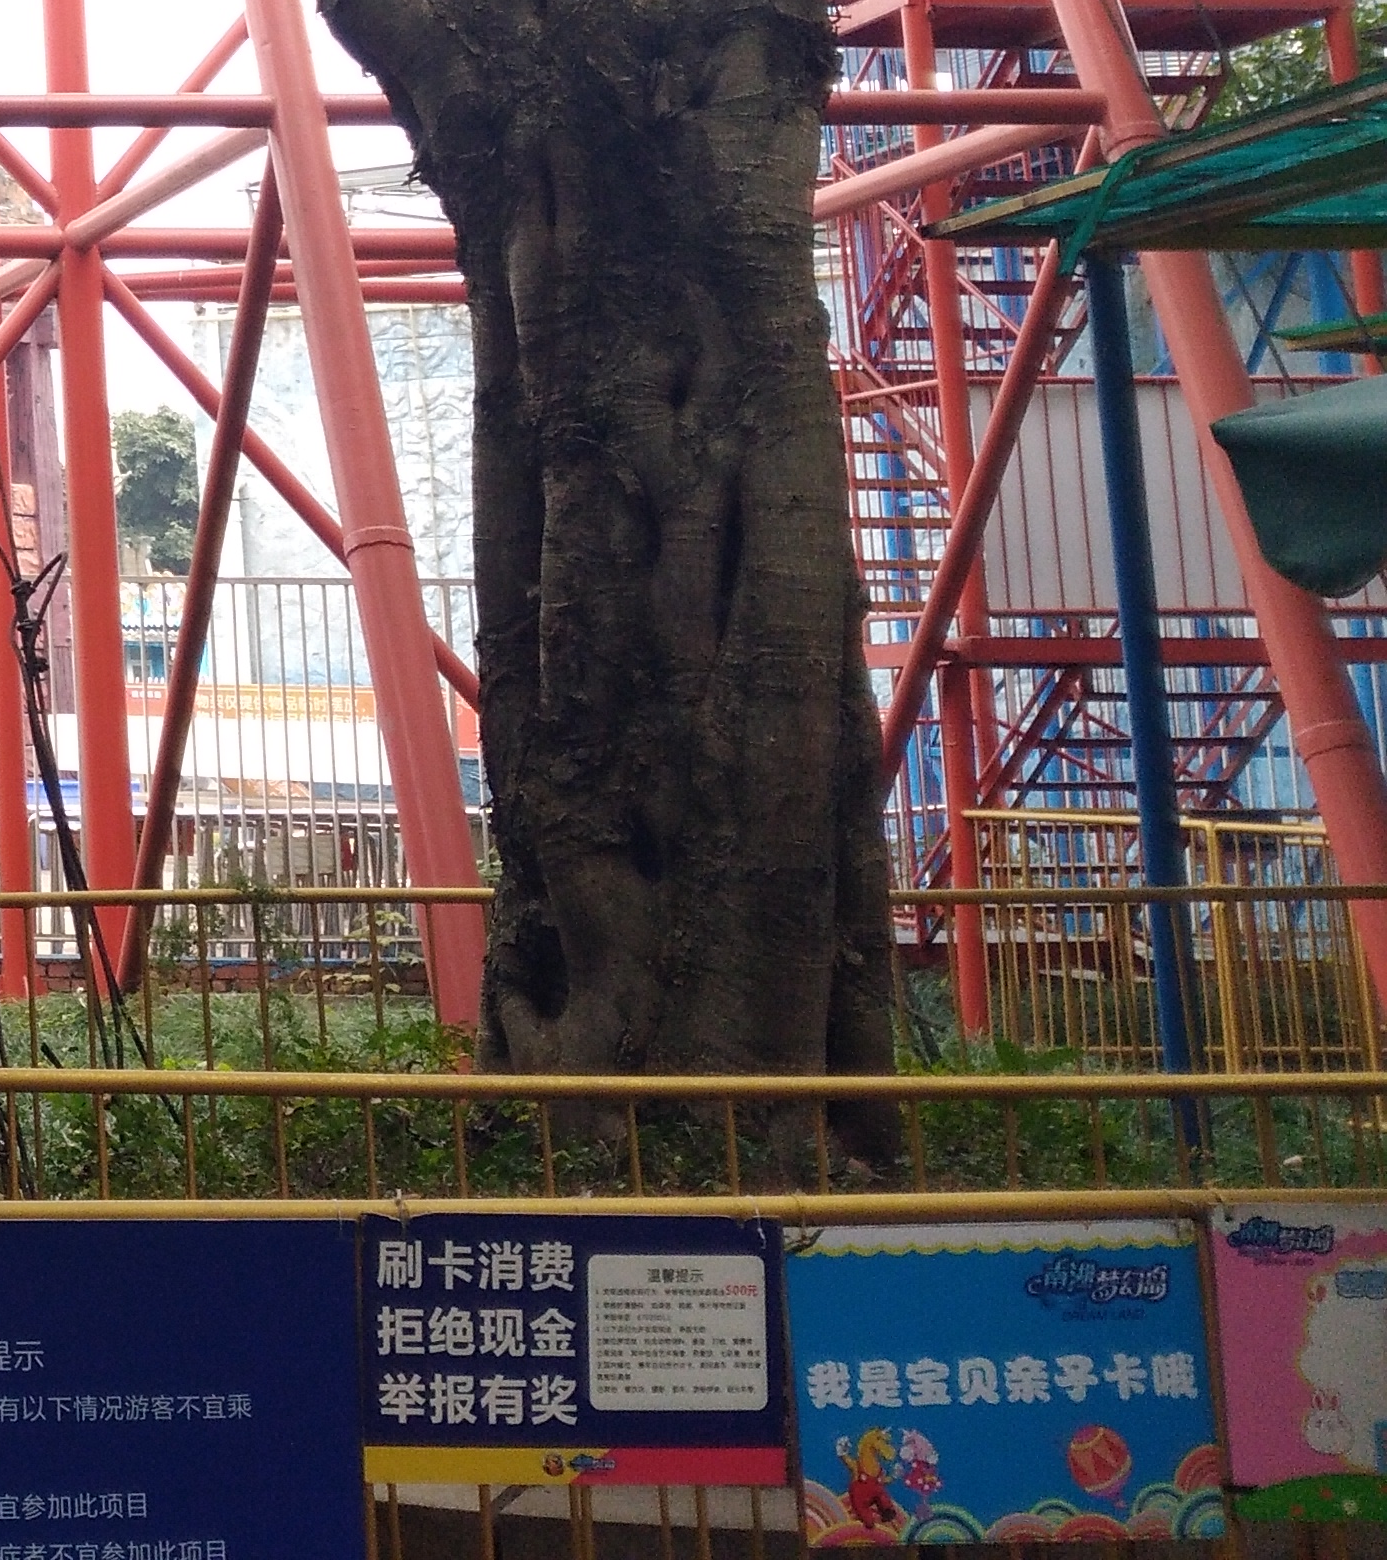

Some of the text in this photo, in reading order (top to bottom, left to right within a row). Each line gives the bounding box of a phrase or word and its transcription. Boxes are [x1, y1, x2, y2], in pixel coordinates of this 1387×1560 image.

[376, 1240, 575, 1292] 刷卡消费
[646, 1268, 704, 1284] 温馨提示
[377, 1306, 577, 1358] 拒绝现金
[378, 1372, 579, 1426] 举报有奖
[806, 1351, 1199, 1409] 我是宝贝亲子卡哦
